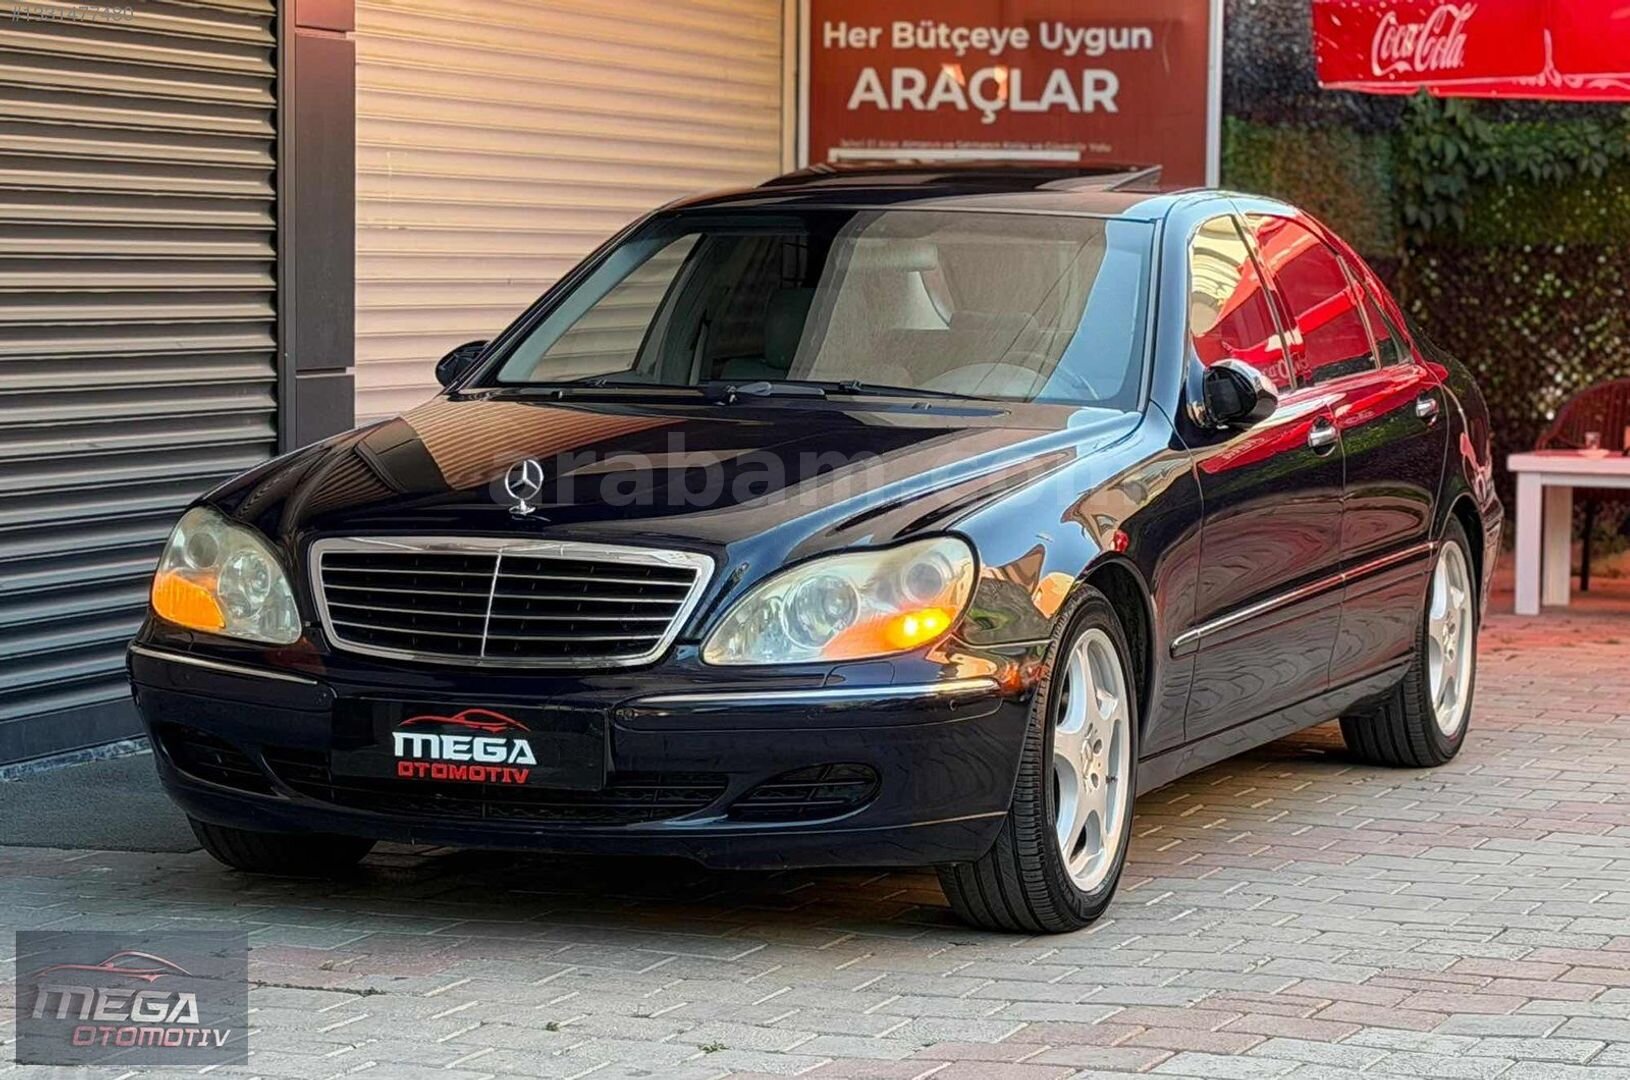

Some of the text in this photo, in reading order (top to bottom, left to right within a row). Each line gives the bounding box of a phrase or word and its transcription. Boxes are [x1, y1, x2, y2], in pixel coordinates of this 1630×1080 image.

[823, 20, 1153, 56] Her Bütçeye Uygun
[847, 67, 1120, 123] ARAÇLAR
[392, 731, 537, 765] MEGA
[397, 761, 529, 784] OTOMOTIV
